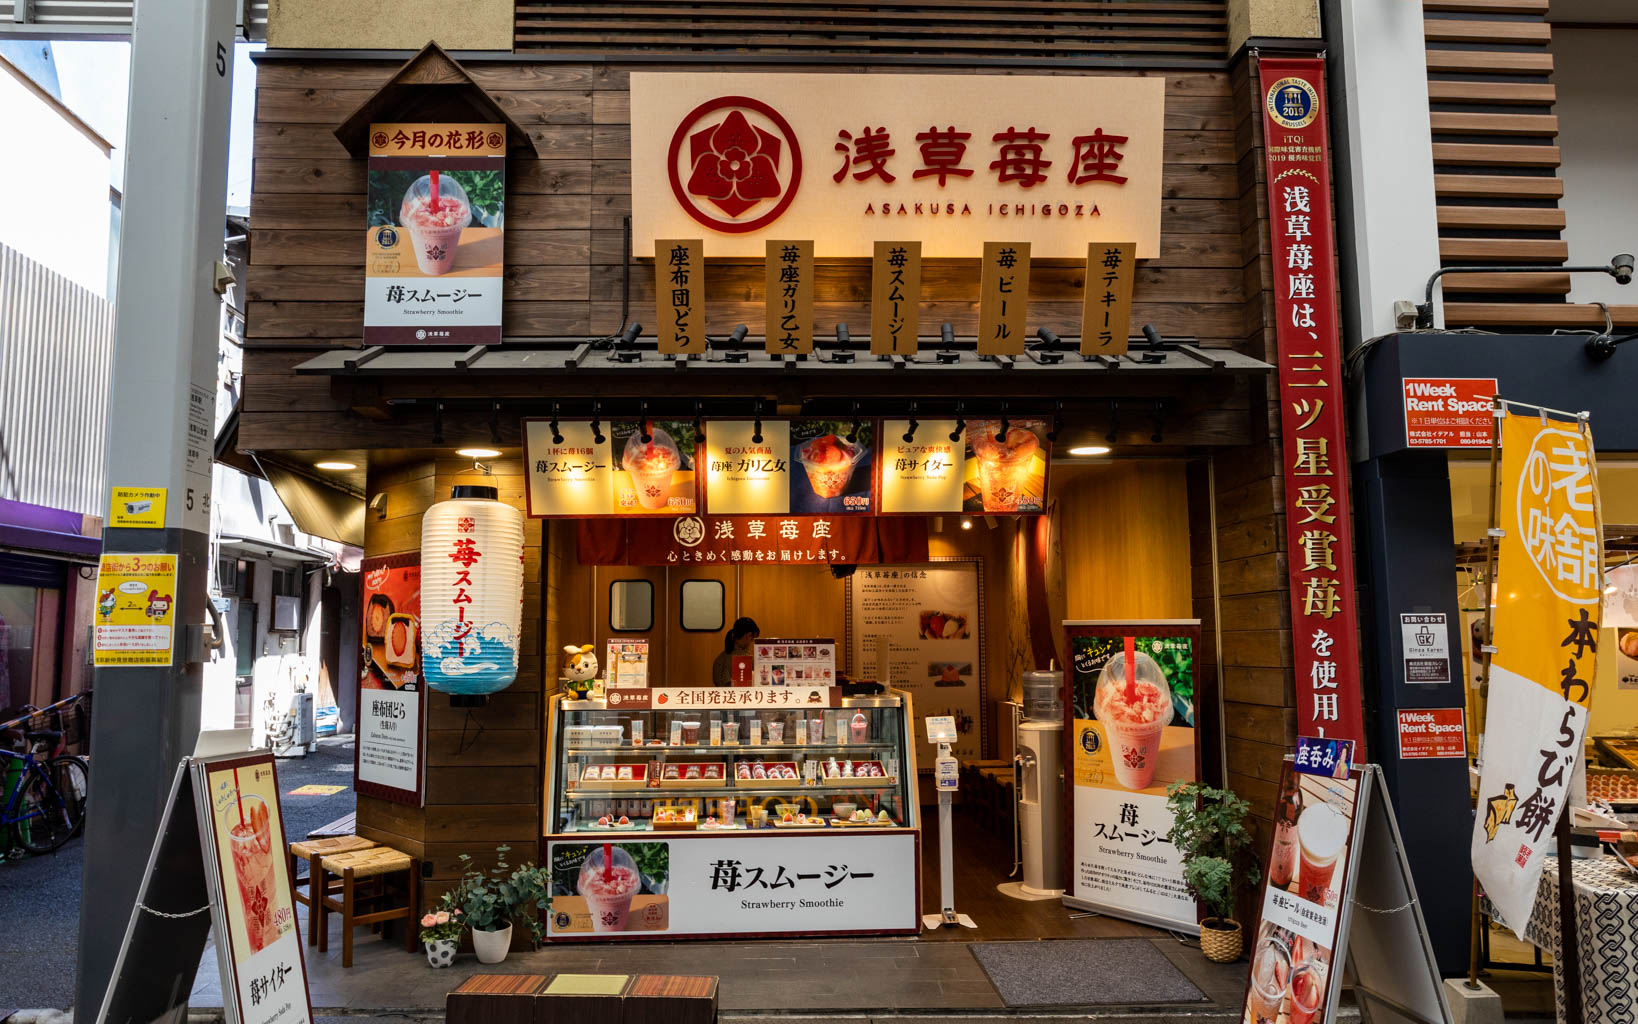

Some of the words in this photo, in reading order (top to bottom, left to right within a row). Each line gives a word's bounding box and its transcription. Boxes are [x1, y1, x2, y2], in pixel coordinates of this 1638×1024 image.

[216, 40, 227, 77] 5
[1283, 107, 1304, 116] 2019
[391, 130, 485, 150] 今月の花形
[1284, 136, 1304, 144] iTQi
[833, 126, 1129, 188] 浅草苺座
[864, 203, 972, 216] ASAKUSA
[989, 203, 1101, 217] ICHIGOZA
[386, 286, 482, 303] 苺スムージー
[668, 245, 690, 348] 座布団どら
[779, 245, 801, 352] 苺座ガリ乙女
[886, 248, 909, 353] 苺スムージー
[995, 249, 1018, 340] 苺ビール
[1100, 249, 1123, 347] 苺テキーラ
[1406, 383, 1456, 396] 1Week
[1407, 398, 1444, 411] Rent
[1447, 398, 1494, 414] Space
[536, 460, 606, 473] 苺スムージー
[895, 458, 953, 471] 苺サイダー
[186, 488, 194, 511] 5
[714, 519, 832, 540] 浅草苺座
[667, 549, 847, 562] 心ときめく感動をお届けします。
[448, 538, 482, 657] 苺スムージー
[1418, 636, 1431, 645] GK
[675, 690, 800, 705] 全国発送承ります。
[372, 699, 406, 719] 座布団どら
[1400, 712, 1435, 723] 1Week
[1401, 723, 1426, 733] Rent
[1428, 723, 1462, 734] Space
[1515, 608, 1597, 843] 本わらび餅
[1297, 744, 1334, 768] 座呑み
[1119, 803, 1139, 827] 苺
[1098, 846, 1134, 859] Strawberry
[1136, 852, 1168, 865] Smoothie
[709, 860, 875, 893] 苺スムージー
[741, 899, 796, 911] Strawberry
[799, 898, 844, 908] Smoothie
[249, 961, 293, 1007] 苺サイダー
